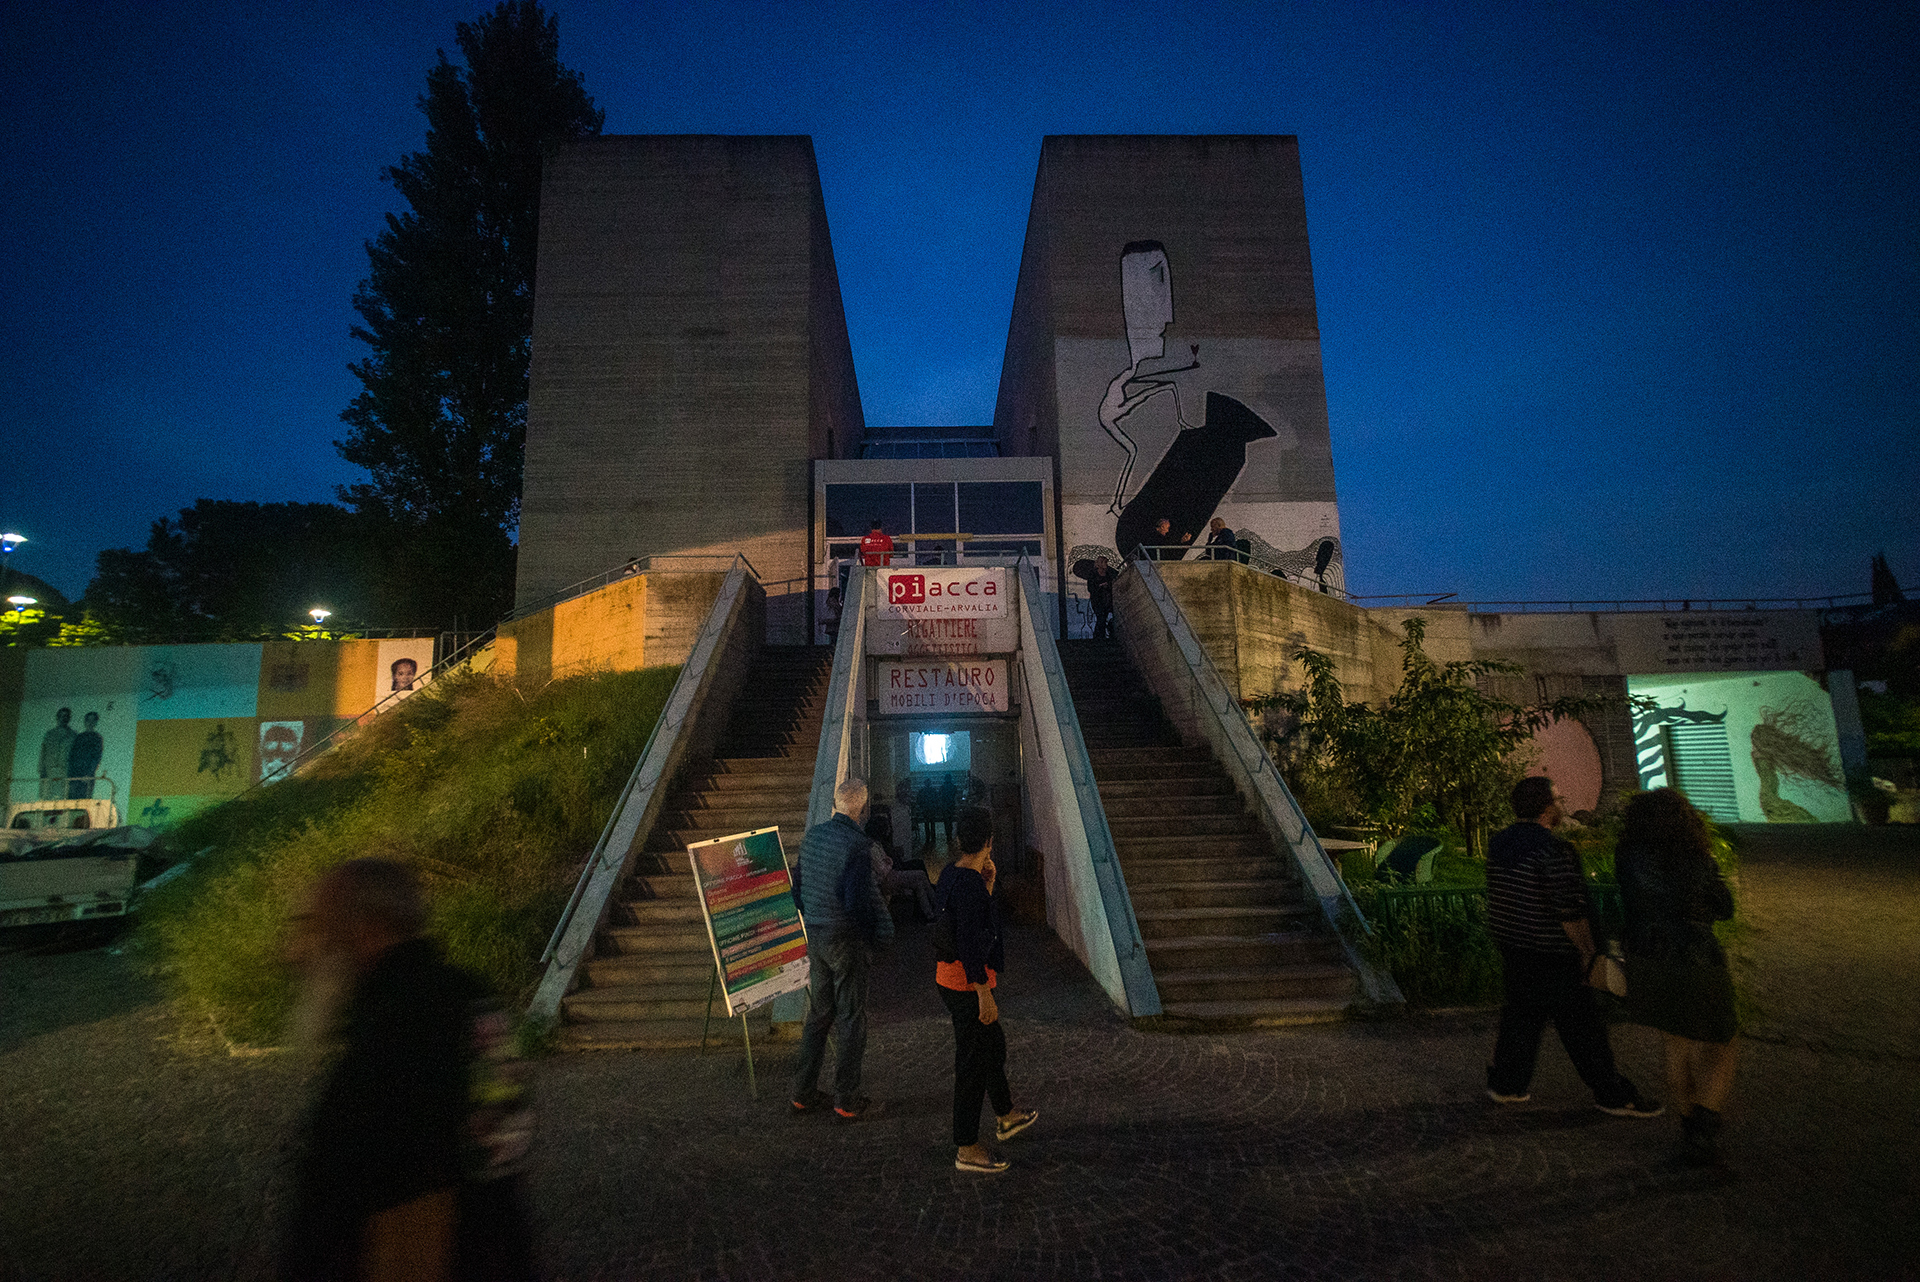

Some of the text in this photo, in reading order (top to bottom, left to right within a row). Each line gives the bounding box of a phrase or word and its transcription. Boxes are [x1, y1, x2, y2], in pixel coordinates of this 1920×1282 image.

[891, 576, 996, 602] piacca
[888, 604, 998, 613] CORVIALE-ARVALIA
[907, 619, 977, 638] RIGATTIERE
[891, 667, 995, 688] RESTAURO
[891, 692, 996, 707] MOBILI D'EPOCA
